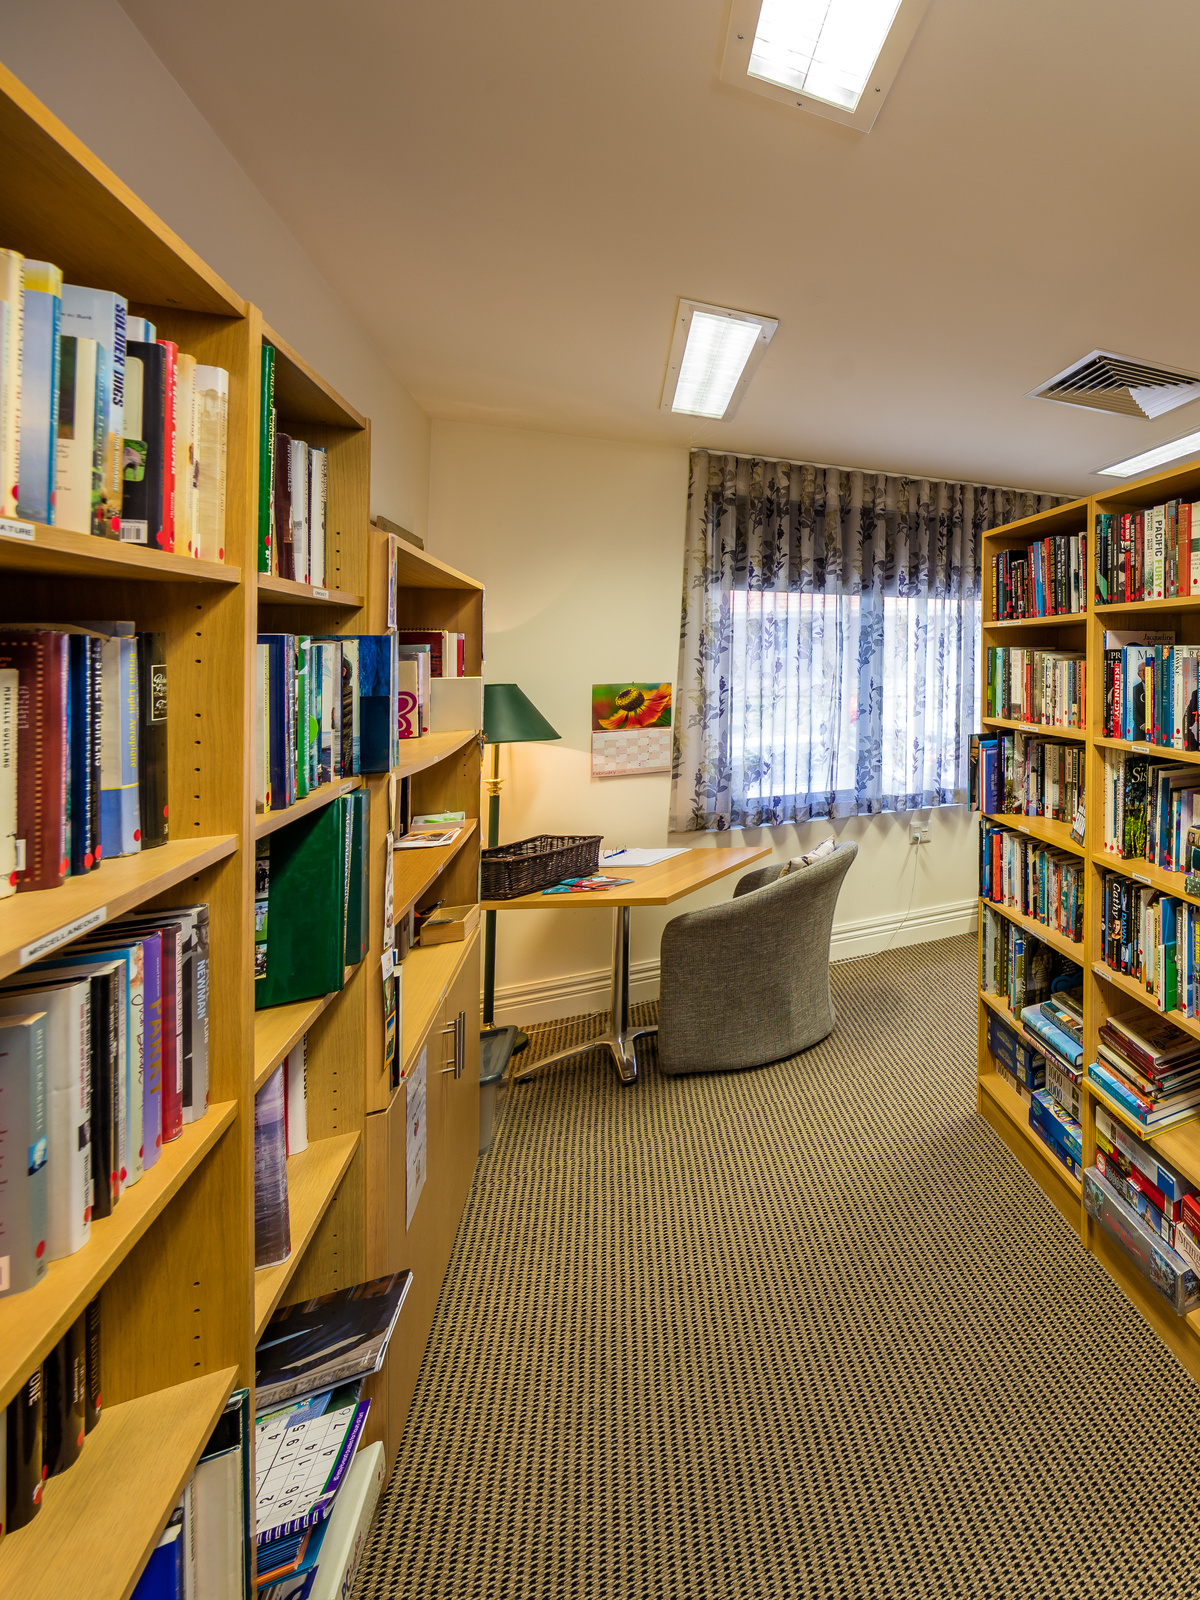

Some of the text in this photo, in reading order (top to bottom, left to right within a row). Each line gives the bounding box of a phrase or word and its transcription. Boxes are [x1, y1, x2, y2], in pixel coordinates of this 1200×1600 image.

[113, 304, 126, 408] SOLDIER DOGS
[1154, 520, 1163, 589] PACIFIC FURY
[128, 653, 138, 768] British Light Aeroplane
[1112, 883, 1121, 919] Cathy
[1120, 912, 1128, 944] DAWN
[28, 914, 101, 956] MISCELLANEOUS
[197, 960, 206, 1020] NEWMAN
[150, 998, 162, 1096] PARKY
[1048, 1064, 1063, 1087] 1000
[35, 1028, 45, 1132] RUTH CRACKNELL
[1048, 1079, 1063, 1102] 1000
[1105, 1211, 1148, 1266] FOUR SEASONS
